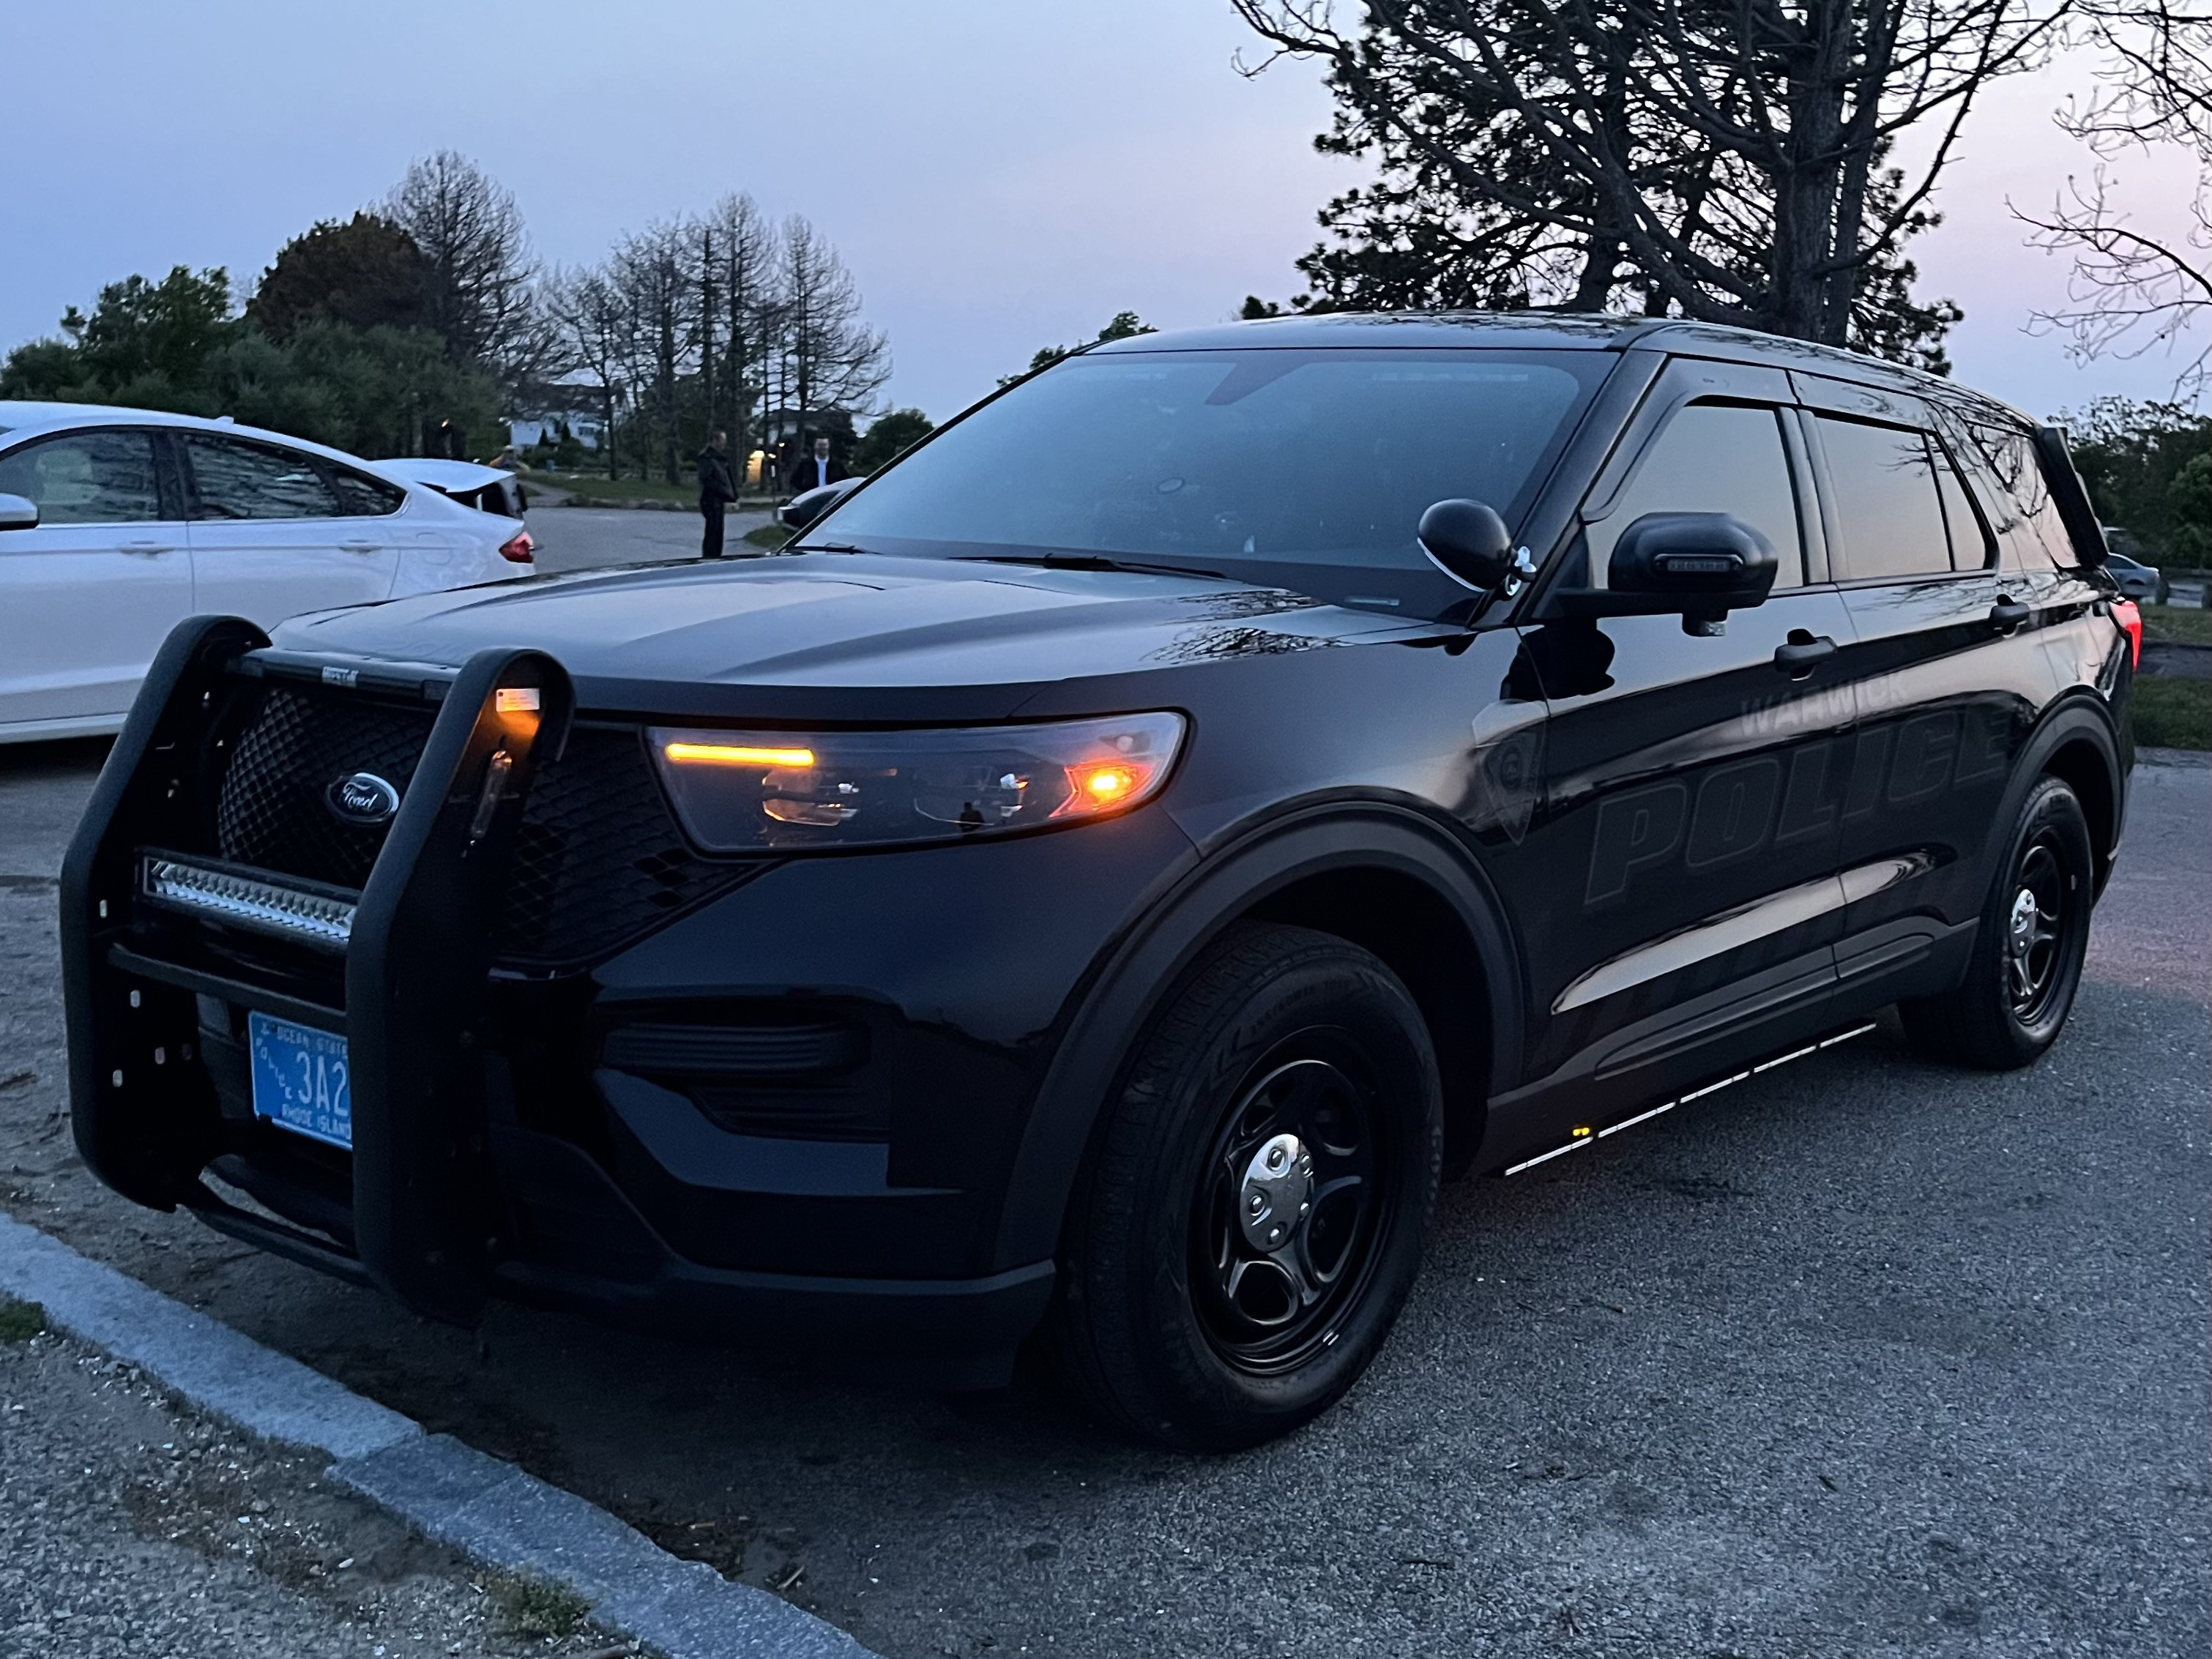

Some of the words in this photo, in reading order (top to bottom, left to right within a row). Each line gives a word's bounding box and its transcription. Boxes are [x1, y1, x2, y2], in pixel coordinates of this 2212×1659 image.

[1740, 671, 1907, 737] WARWICK
[342, 782, 379, 812] Ford
[1584, 705, 2011, 905] POLICE
[297, 1051, 349, 1116] 3A2
